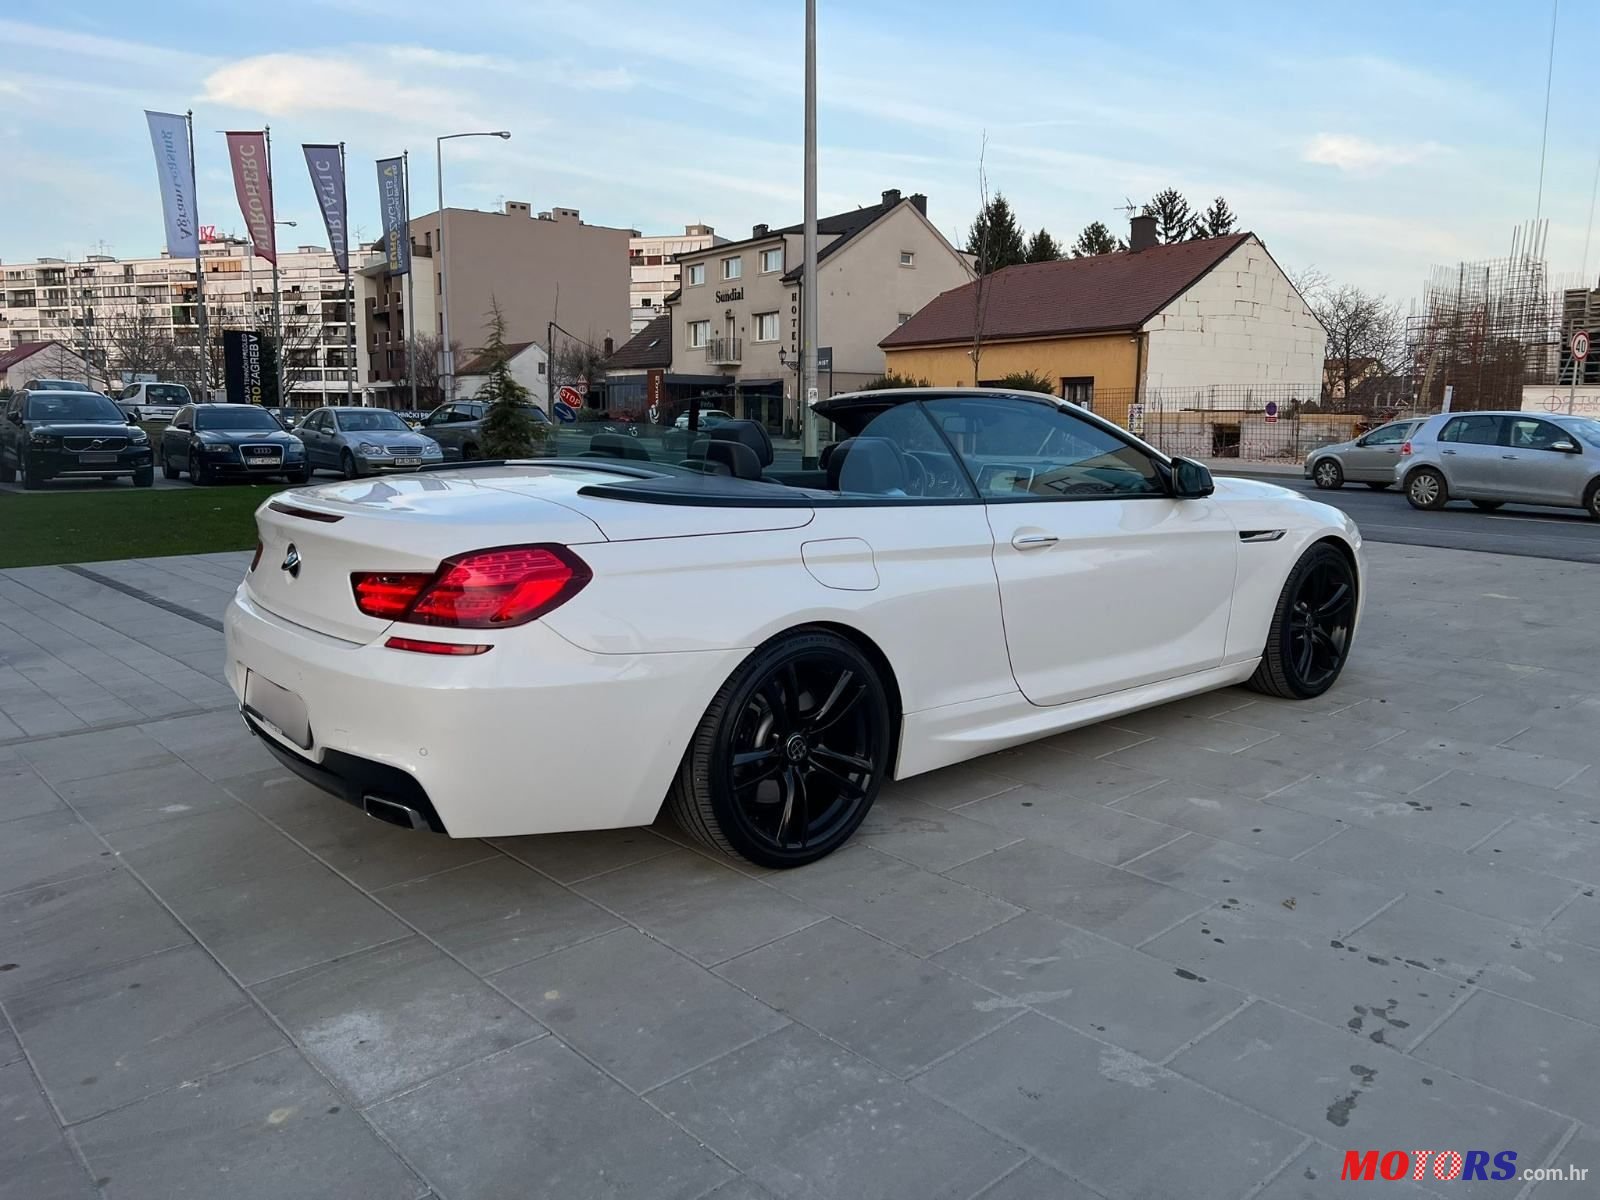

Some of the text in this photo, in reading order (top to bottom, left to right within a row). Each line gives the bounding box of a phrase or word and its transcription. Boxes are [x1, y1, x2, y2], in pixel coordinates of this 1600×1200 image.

[715, 286, 745, 304] Sundial
[1575, 339, 1586, 353] 40
[560, 389, 581, 405] STOP
